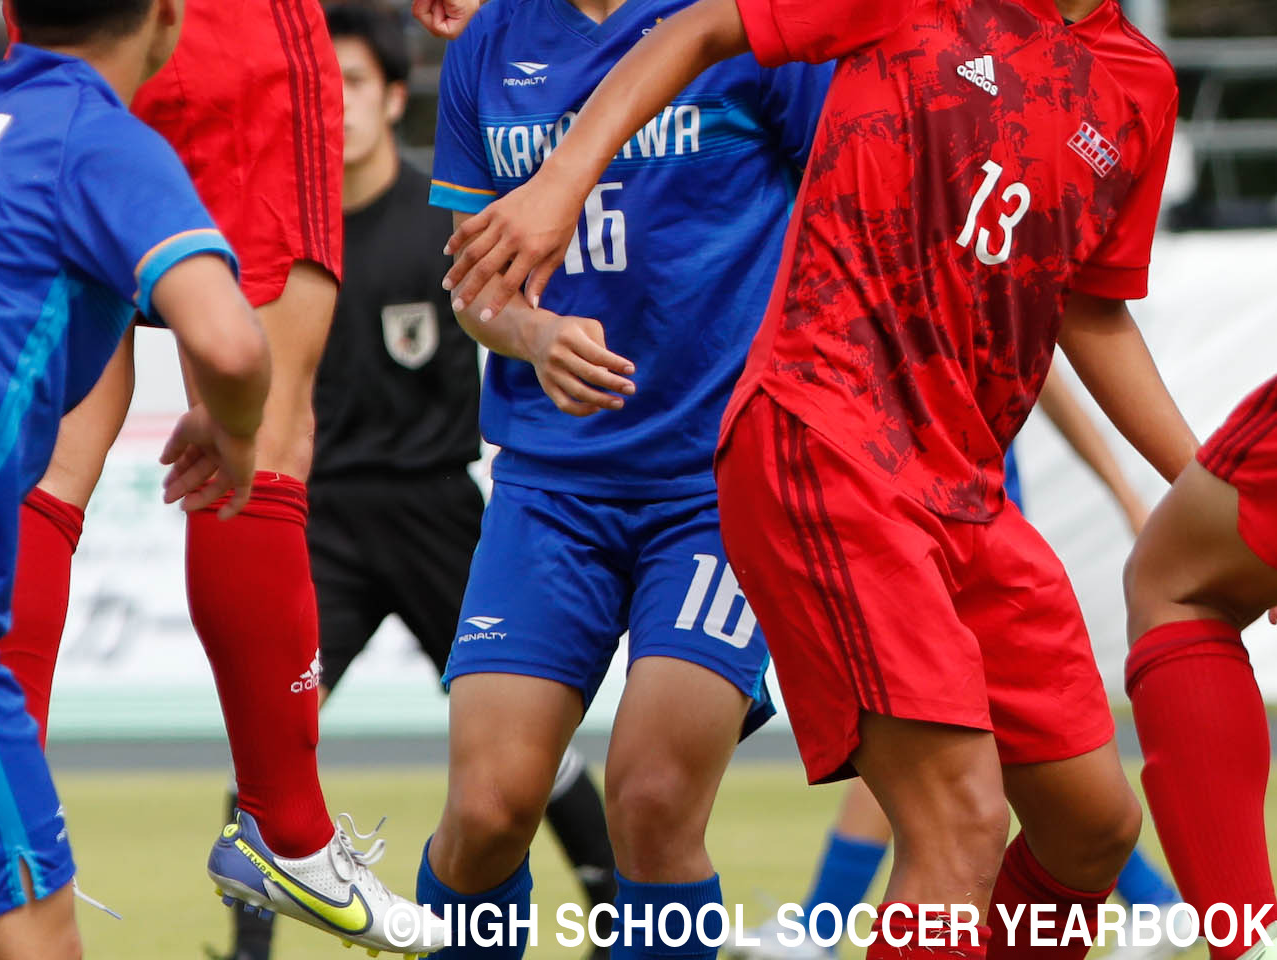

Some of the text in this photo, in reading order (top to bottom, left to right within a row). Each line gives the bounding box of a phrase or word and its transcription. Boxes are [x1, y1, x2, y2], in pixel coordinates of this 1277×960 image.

[502, 75, 547, 87] PENALTY
[956, 64, 998, 97] adidas
[955, 159, 1031, 266] 13
[674, 553, 758, 649] 16
[458, 631, 508, 644] PENALTY
